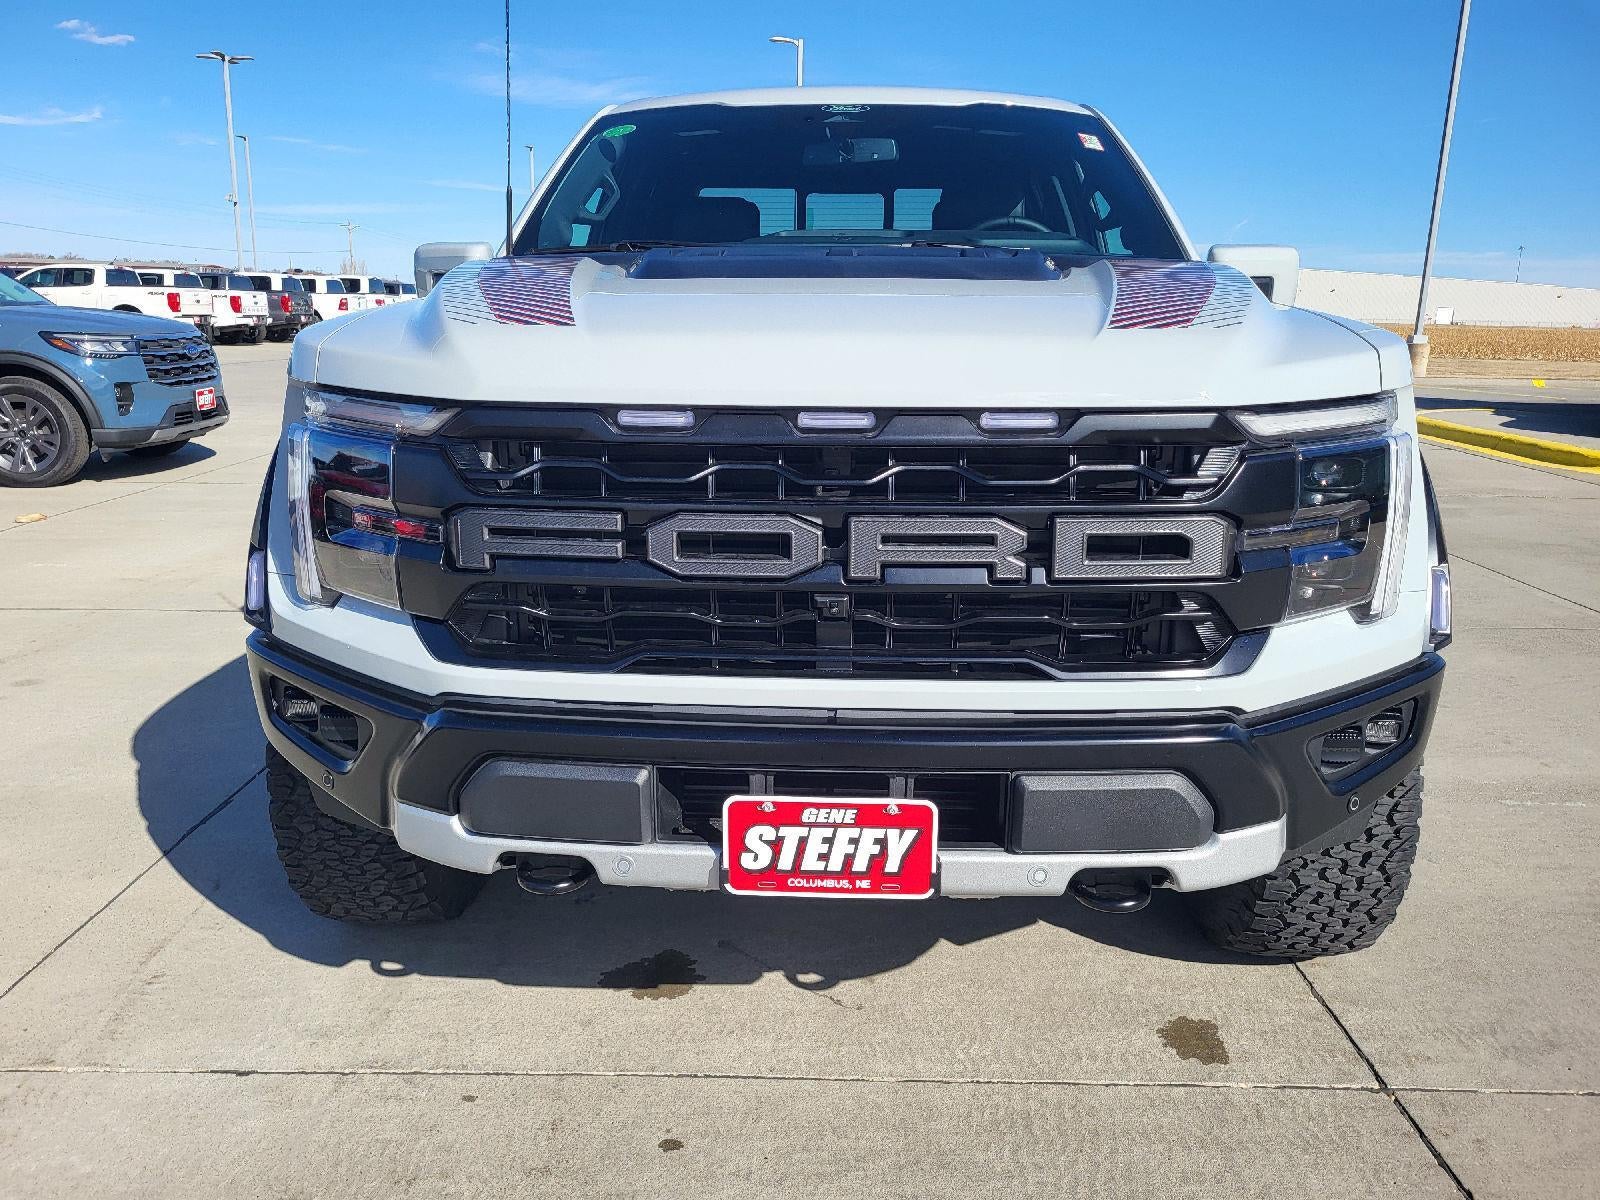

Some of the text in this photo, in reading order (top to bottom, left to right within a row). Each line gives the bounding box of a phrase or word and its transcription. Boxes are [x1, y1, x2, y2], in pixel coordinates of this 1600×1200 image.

[451, 507, 1237, 581] FORD
[801, 808, 858, 824] GENE
[739, 824, 922, 875] STEFFY
[787, 877, 871, 890] COLUMBUS, NE
